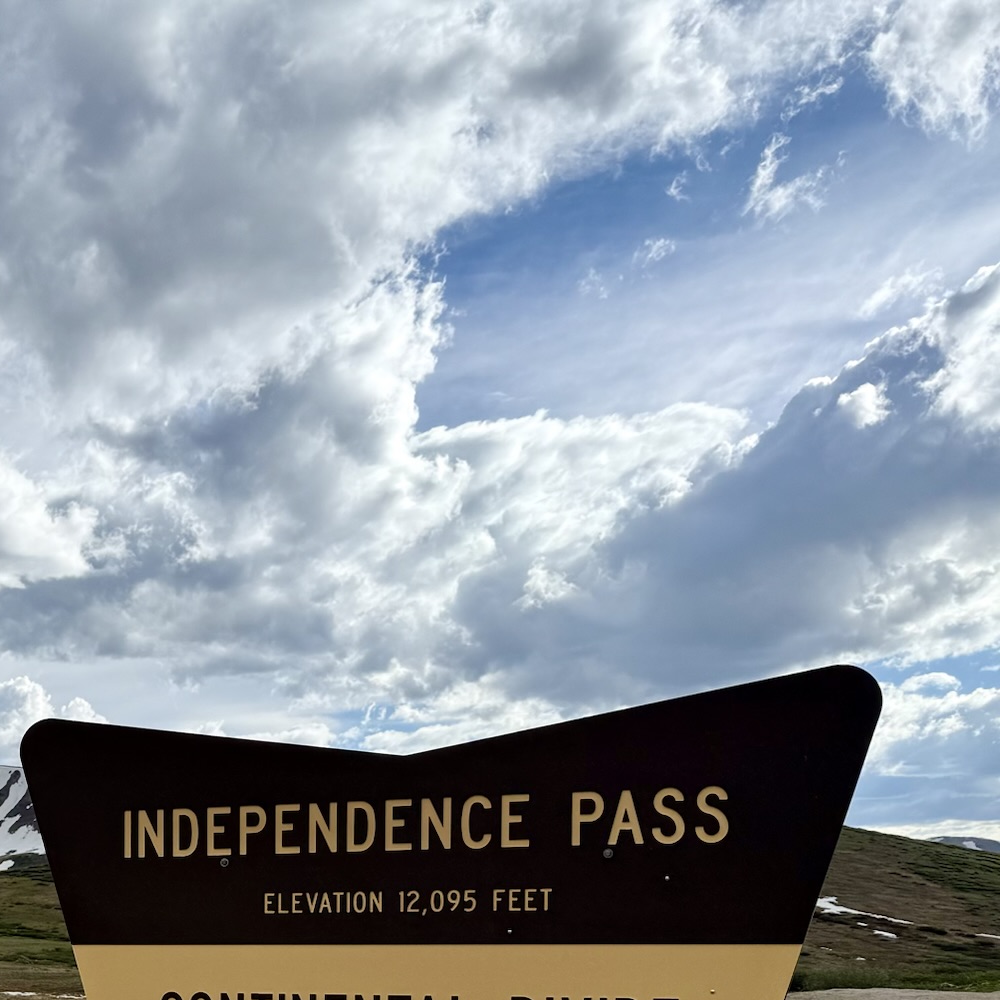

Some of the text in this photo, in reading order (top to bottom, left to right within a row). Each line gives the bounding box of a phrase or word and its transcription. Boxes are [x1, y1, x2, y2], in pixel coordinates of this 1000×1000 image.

[124, 786, 729, 859] INDEPENDENCE PASS
[264, 888, 553, 916] ELEVATION 12,095 FEET
